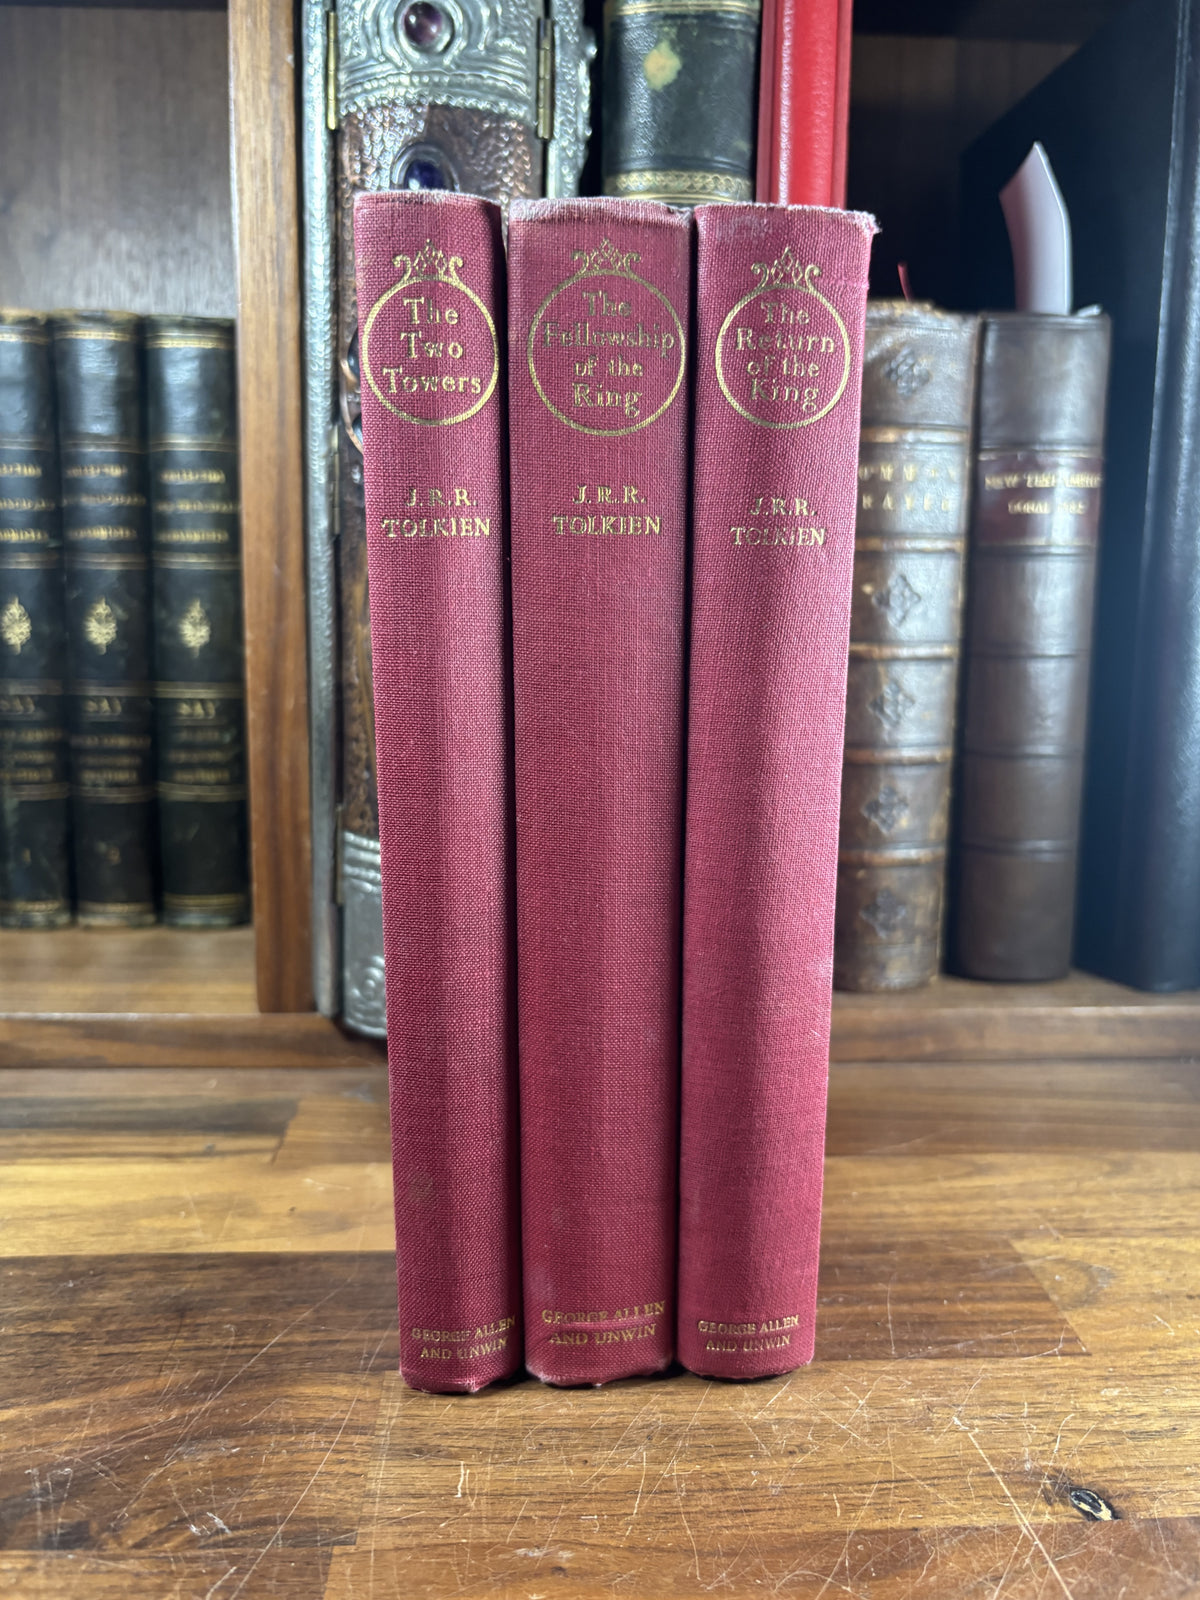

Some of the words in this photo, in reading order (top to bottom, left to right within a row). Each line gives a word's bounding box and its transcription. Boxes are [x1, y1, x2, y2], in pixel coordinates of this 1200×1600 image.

[402, 296, 459, 325] The
[582, 290, 632, 317] The
[760, 301, 810, 325] The
[400, 330, 464, 359] Two
[542, 322, 675, 359] Fellowship
[736, 327, 836, 353] Return
[573, 354, 599, 377] of
[608, 353, 644, 377] the
[747, 355, 775, 377] of
[782, 354, 820, 377] the
[382, 366, 482, 394] Towers
[572, 382, 643, 419] Ring
[751, 378, 819, 413] King
[381, 517, 491, 538] TOLKIEN
[553, 515, 662, 536] TOLKIEN
[730, 526, 827, 546] TOLKIEN
[541, 1309, 608, 1325] GEORGE
[614, 1301, 665, 1321] ALLEN
[697, 1320, 757, 1335] GEORGE
[759, 1315, 800, 1334] ALLEN
[411, 1327, 471, 1342] GEORGE
[474, 1315, 516, 1340] ALLEN
[549, 1331, 589, 1345] AND
[593, 1324, 657, 1344] UNWIN
[420, 1347, 453, 1359] AND
[456, 1337, 508, 1359] UNWIN
[706, 1340, 738, 1351] AND
[743, 1335, 791, 1352] UNWIN
